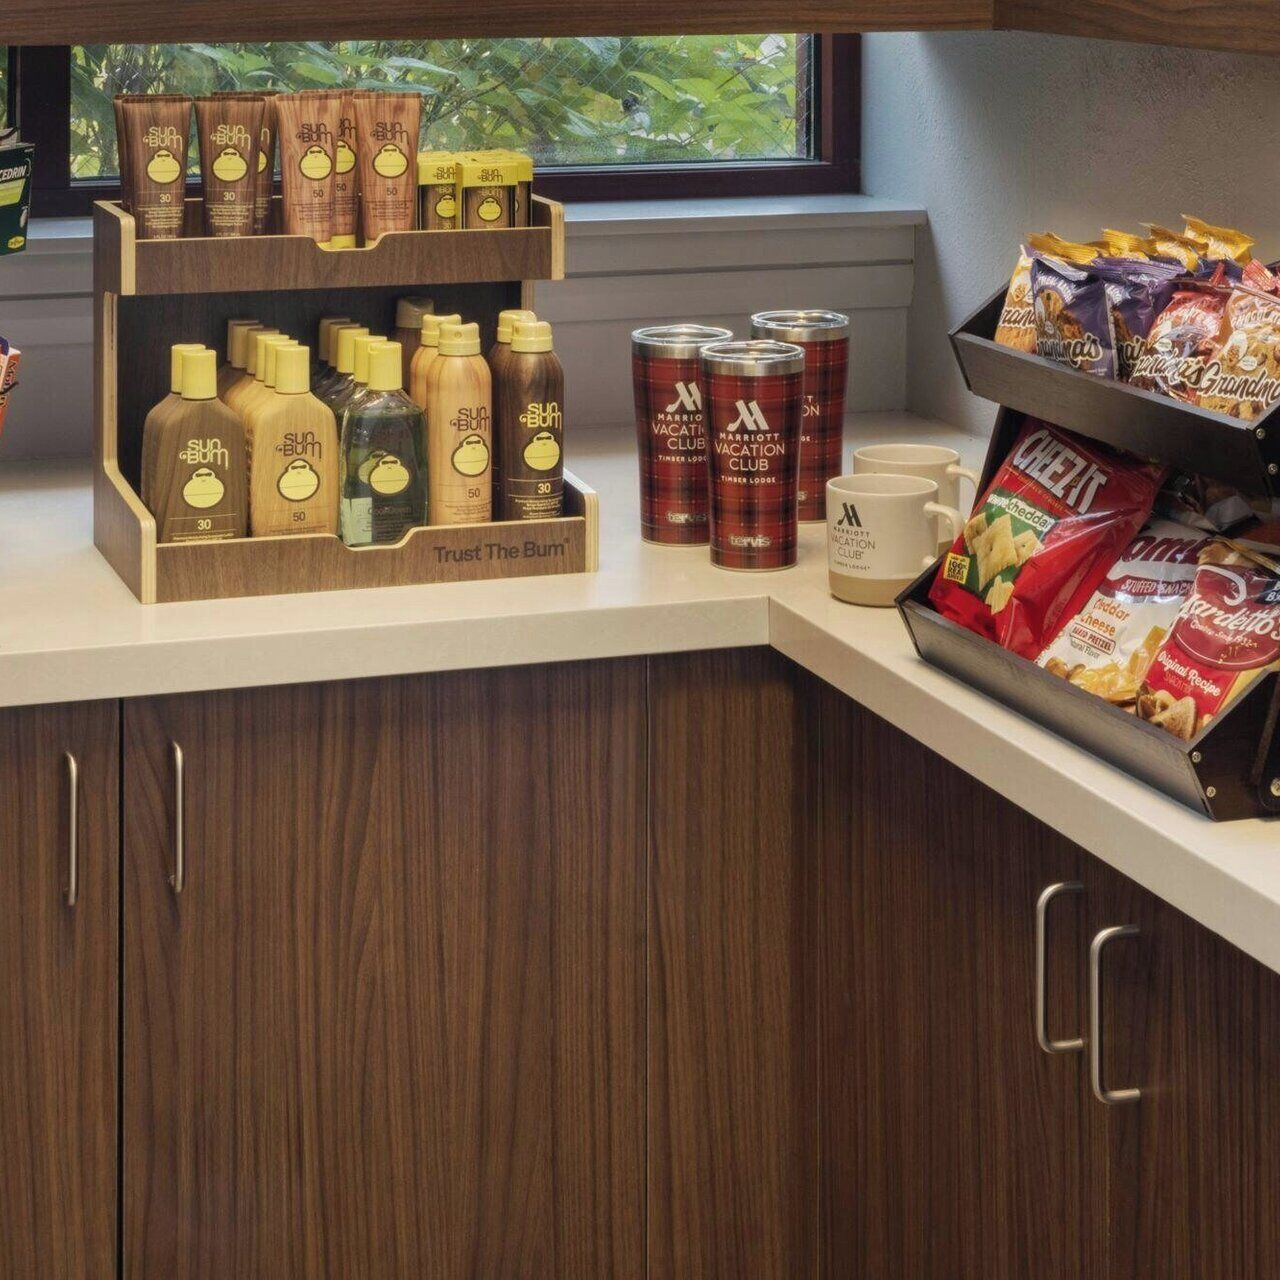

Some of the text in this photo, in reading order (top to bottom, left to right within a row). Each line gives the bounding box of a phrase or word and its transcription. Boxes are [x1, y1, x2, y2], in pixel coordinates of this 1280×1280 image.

[223, 191, 235, 201] 30
[313, 189, 324, 199] 50
[386, 187, 398, 196] 50
[159, 193, 171, 203] 30
[667, 437, 705, 450] CLUB
[720, 433, 780, 442] MARRIOTT
[714, 442, 786, 456] VACATION
[728, 458, 769, 471] CLUB
[537, 483, 551, 494] 30
[831, 534, 876, 550] VACATION
[433, 541, 564, 564] Trust The Bum
[1190, 669, 1221, 697] Recipe
